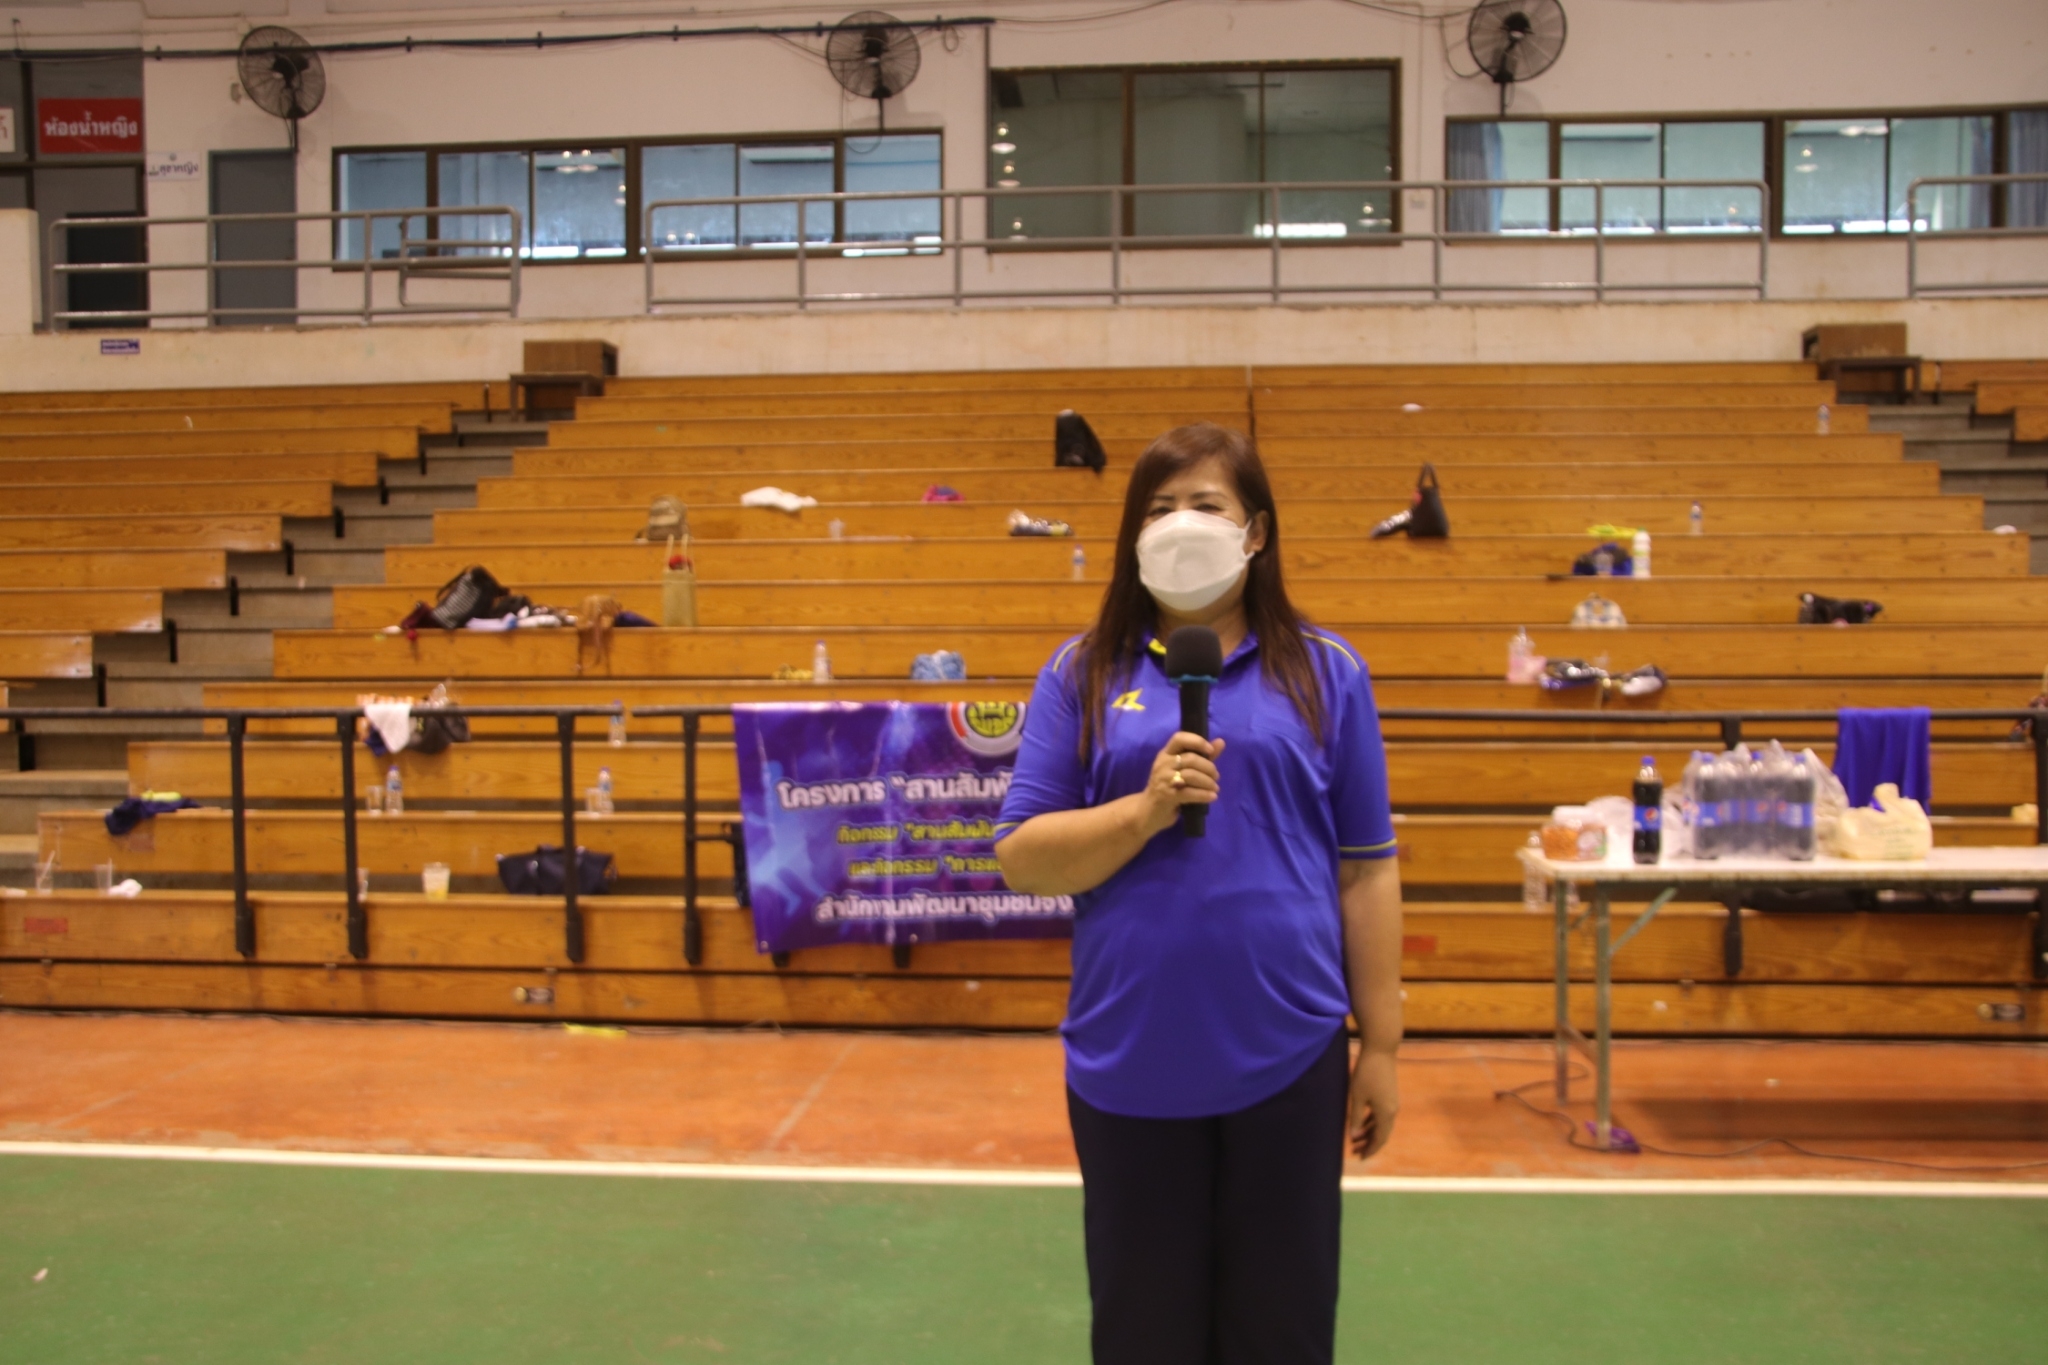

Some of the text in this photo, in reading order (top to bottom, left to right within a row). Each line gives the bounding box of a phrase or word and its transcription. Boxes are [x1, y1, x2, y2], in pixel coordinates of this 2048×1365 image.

[43, 110, 138, 138] ห้องน้ำหญิง
[776, 780, 885, 809] โครงการ
[837, 825, 898, 844] กิจกรรม
